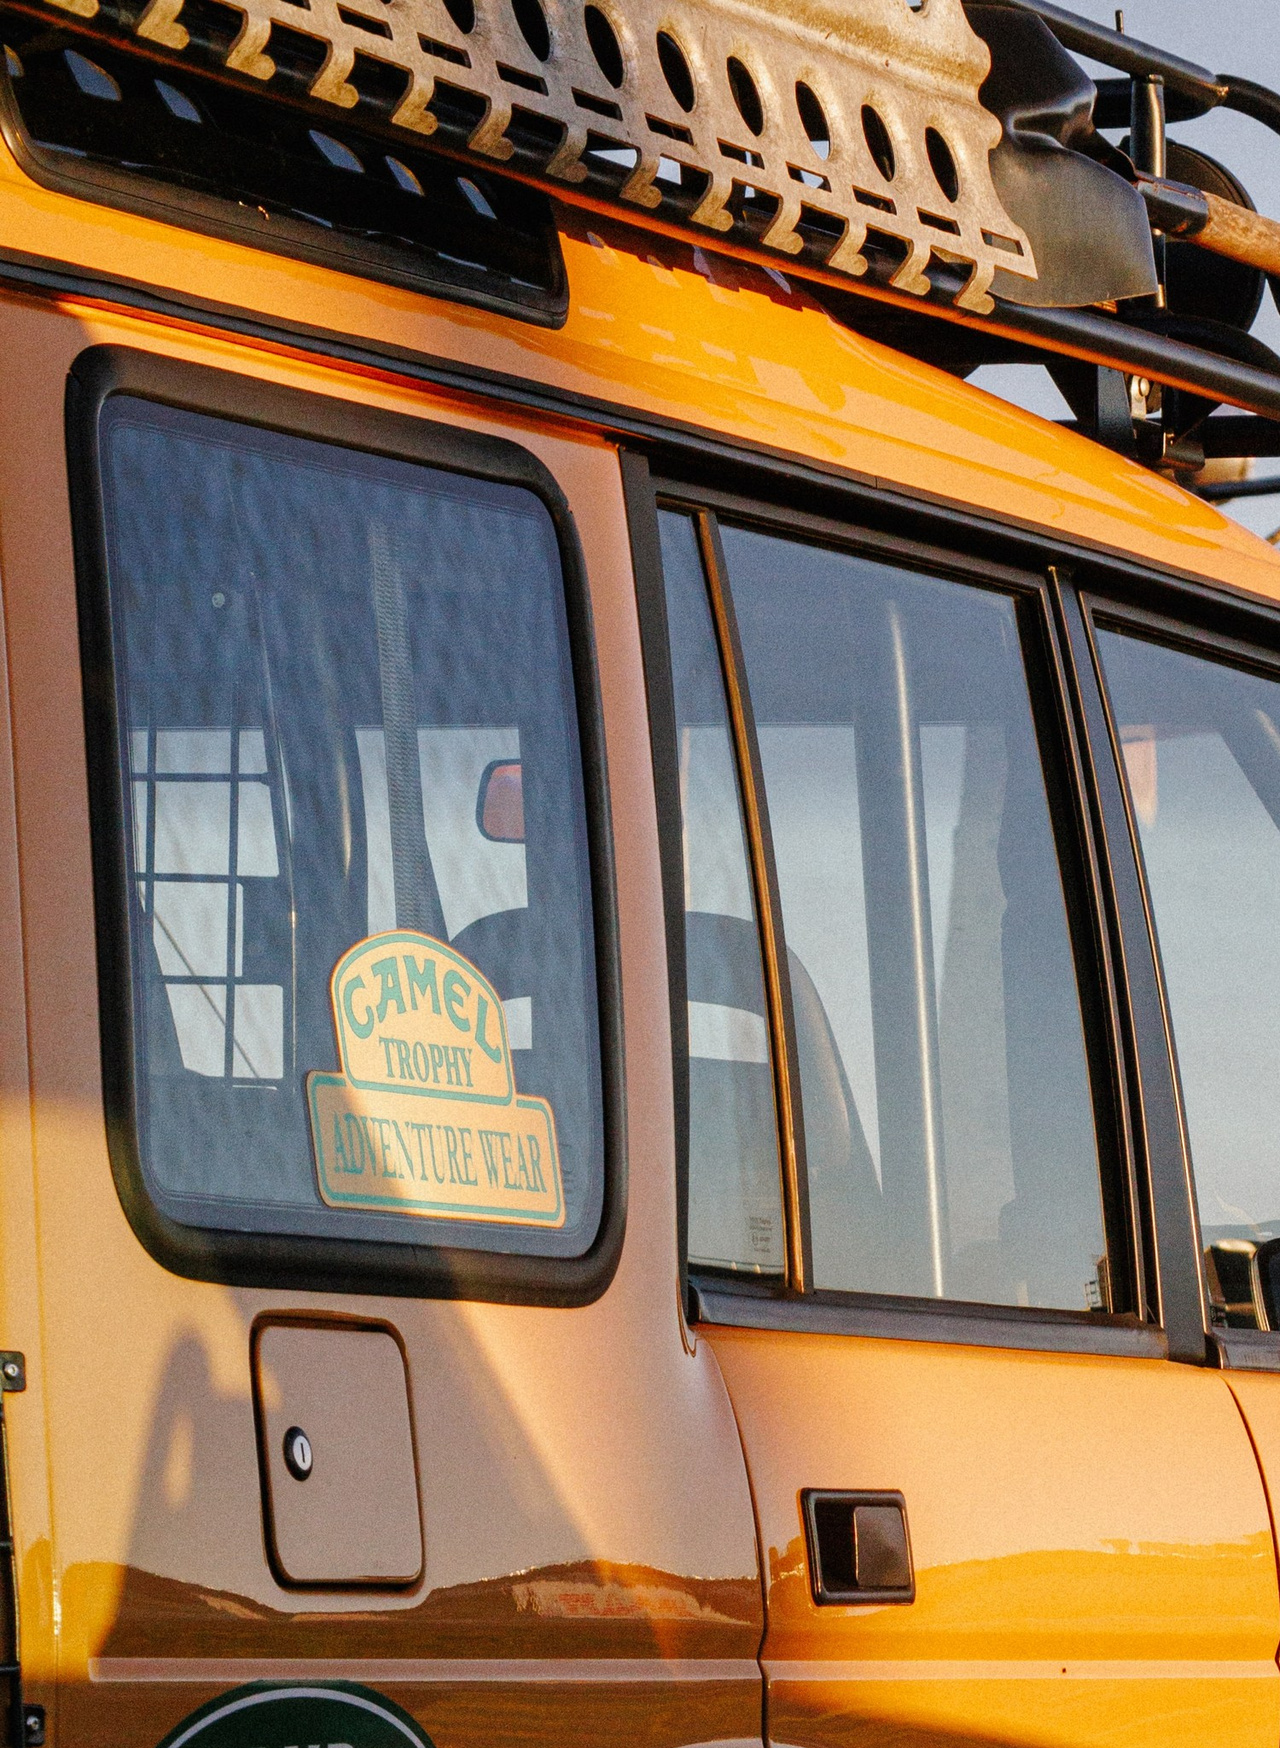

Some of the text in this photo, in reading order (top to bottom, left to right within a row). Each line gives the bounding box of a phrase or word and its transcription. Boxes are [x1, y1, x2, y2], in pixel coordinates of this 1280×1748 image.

[344, 954, 504, 1064] CAMEL
[379, 1036, 474, 1088] TROPHY
[333, 1111, 548, 1194] ADVENTURE WEAR
